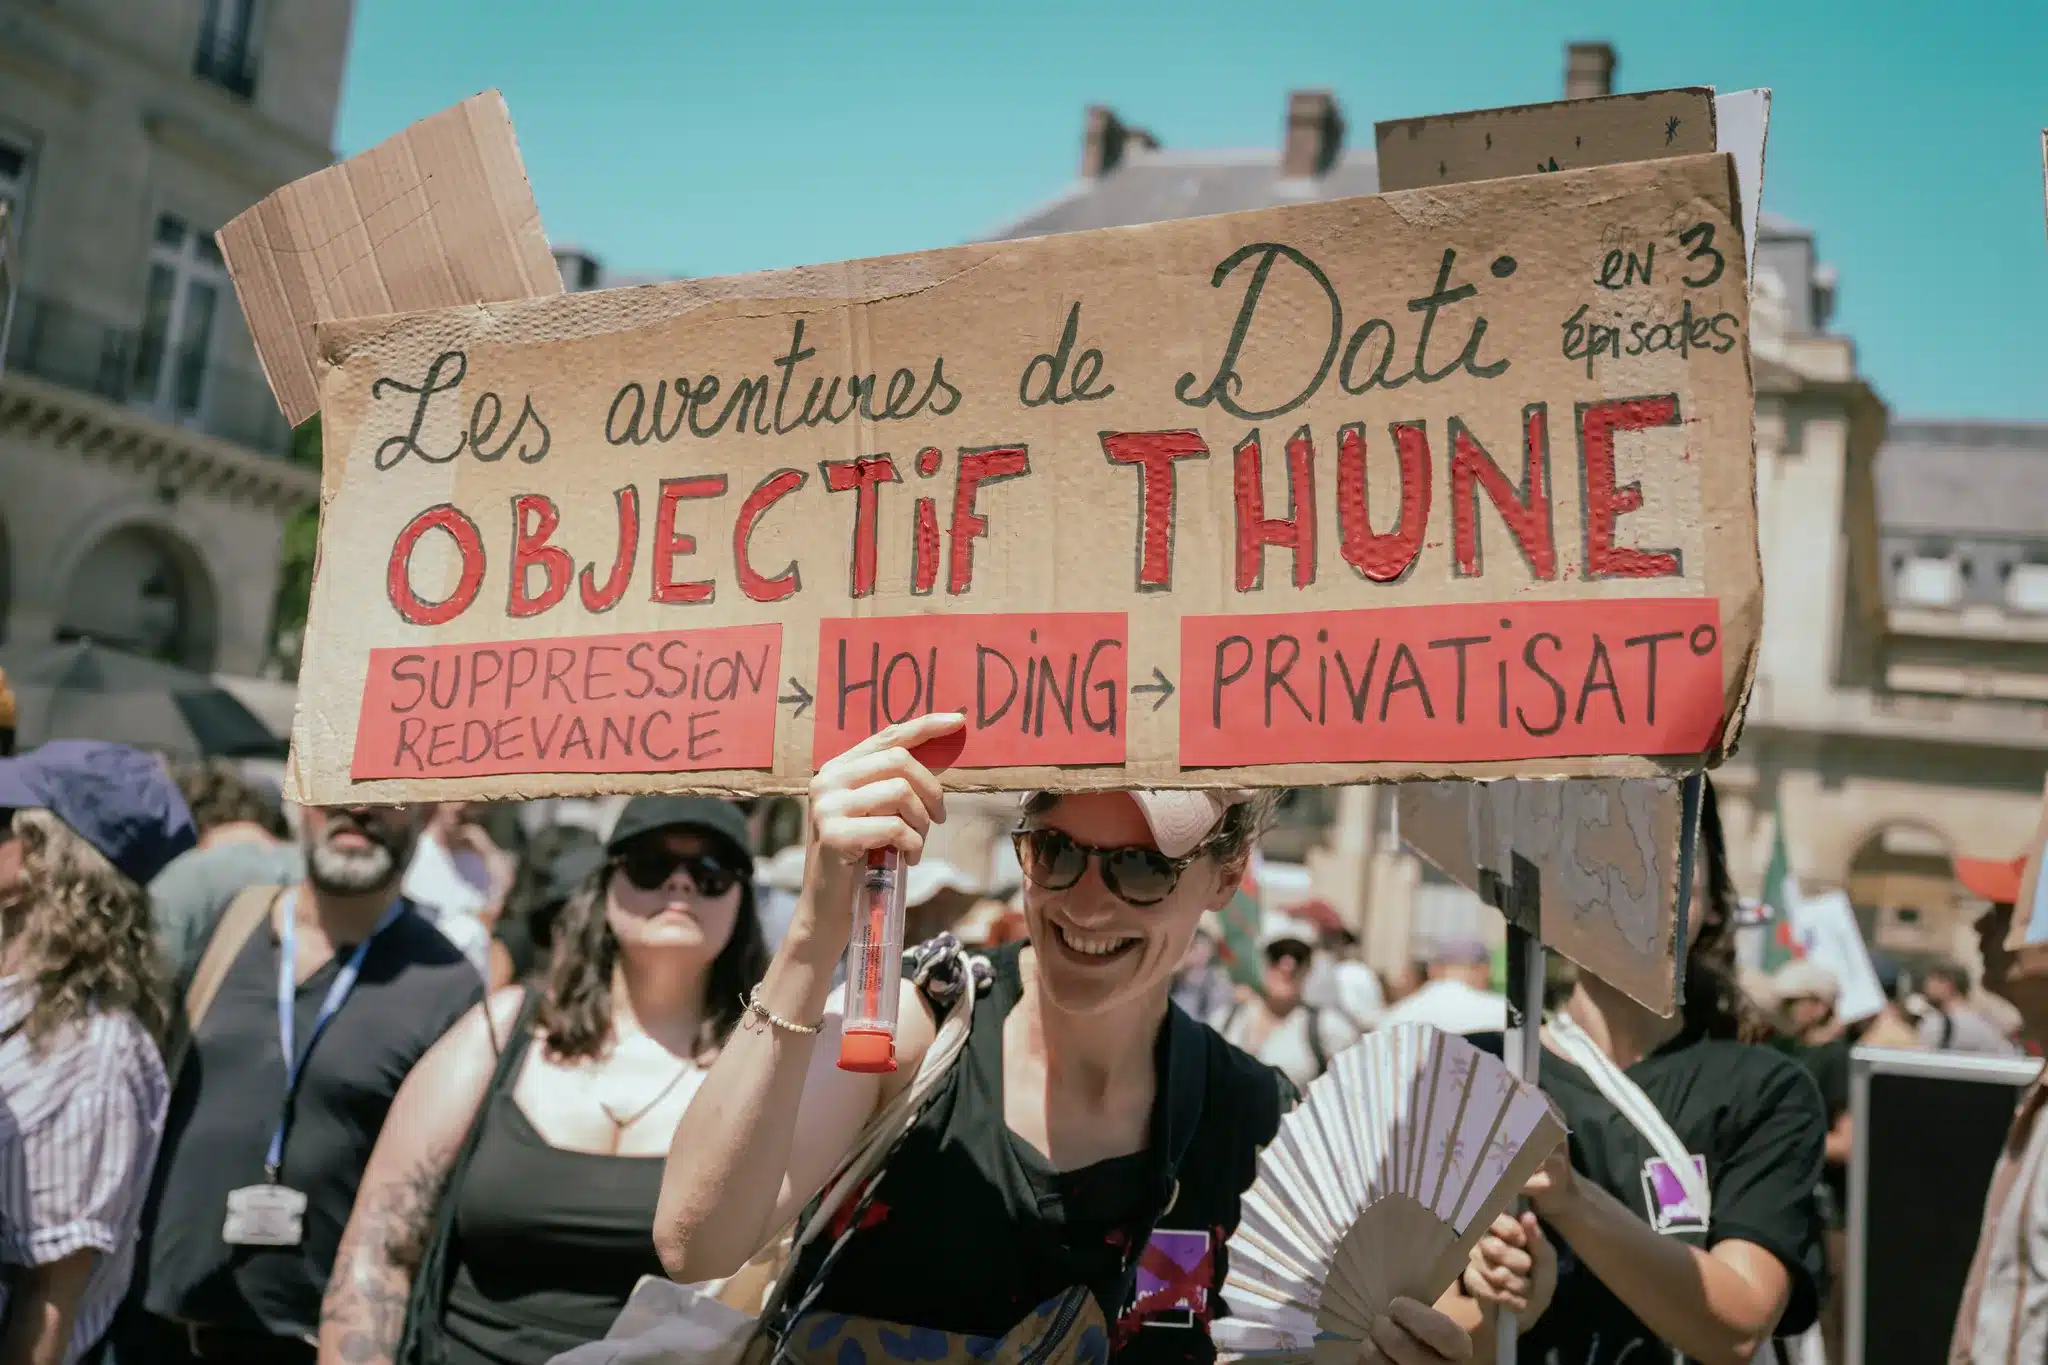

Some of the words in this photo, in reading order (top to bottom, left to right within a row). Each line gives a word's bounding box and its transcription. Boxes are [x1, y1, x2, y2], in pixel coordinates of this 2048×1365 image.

[1680, 222, 1725, 289] 3
[374, 350, 551, 471] Les
[607, 318, 963, 446] aventures
[1020, 301, 1116, 408] de
[1175, 242, 1518, 422] Dati
[1562, 300, 1740, 380] épisodes
[1100, 393, 1684, 594] THUNE
[393, 709, 724, 772] REDEVANCE
